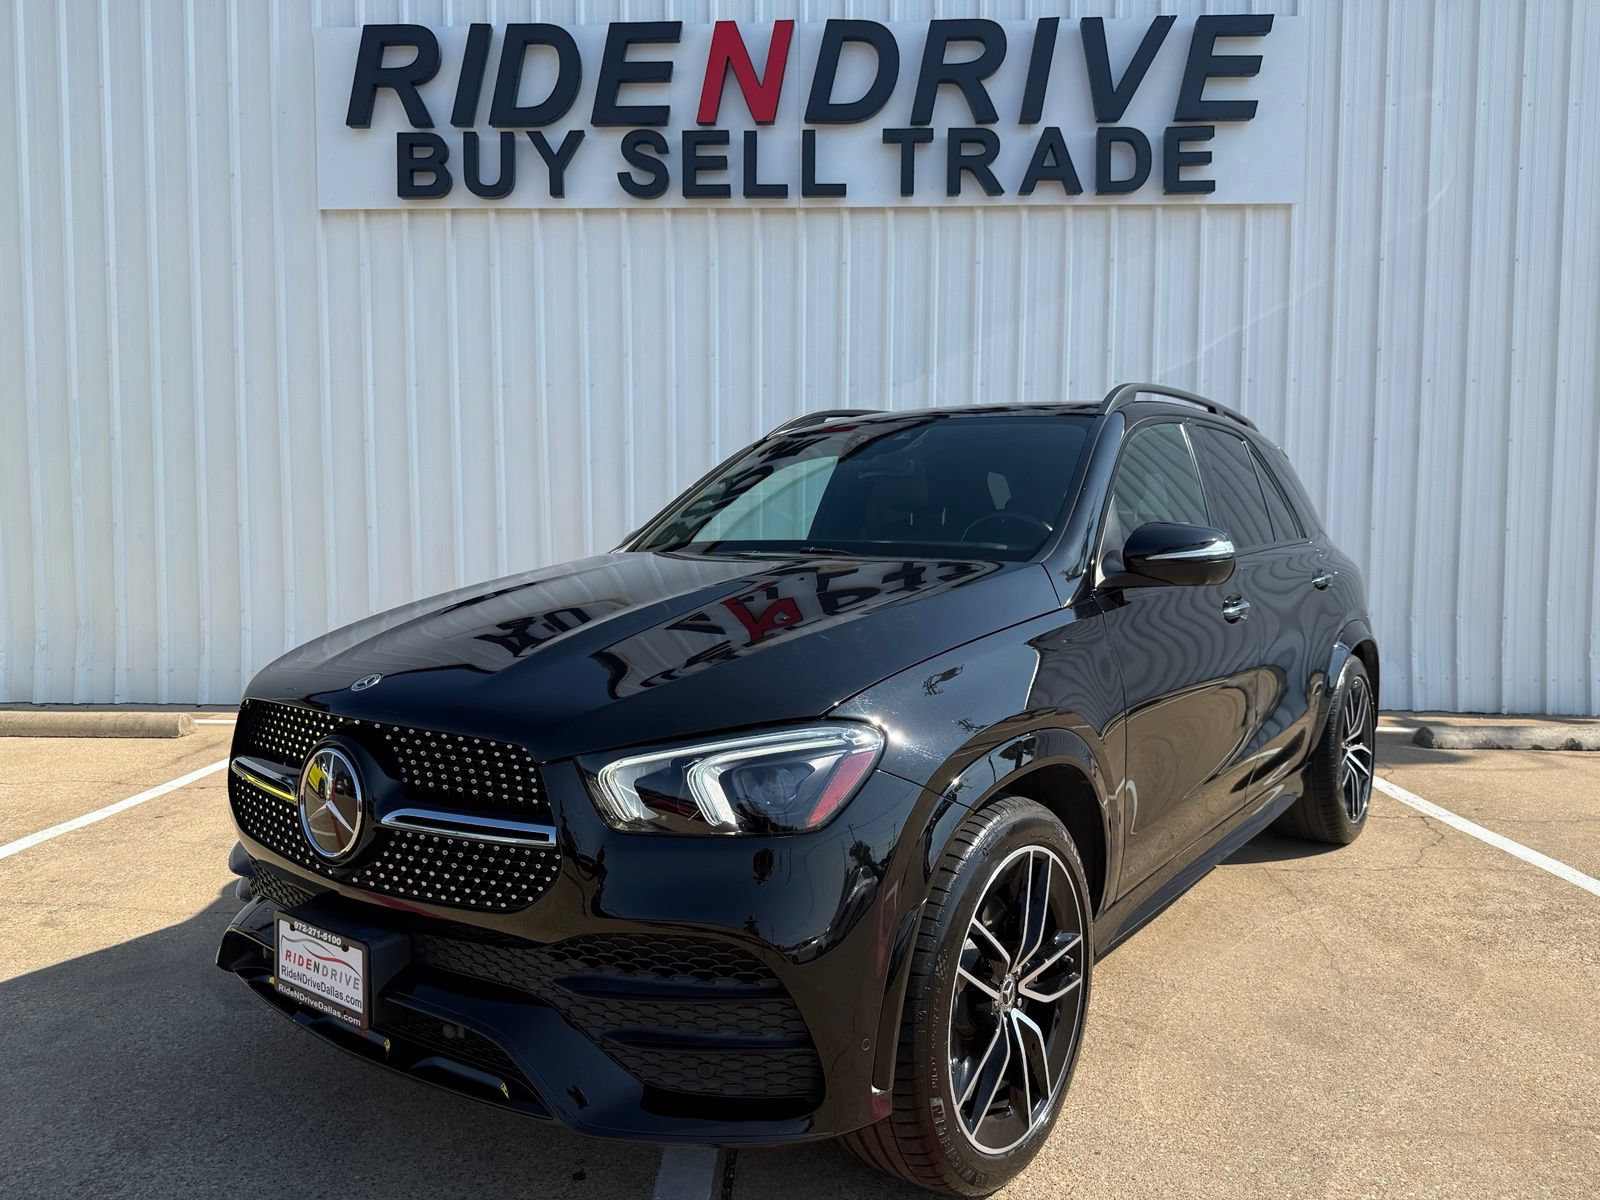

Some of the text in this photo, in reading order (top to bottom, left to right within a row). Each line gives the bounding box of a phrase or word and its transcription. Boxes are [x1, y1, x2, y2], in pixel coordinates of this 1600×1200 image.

[397, 125, 1216, 199] BUY SELL TRADE
[294, 921, 342, 946] 972-271-5100
[281, 965, 362, 1008] RideNDriveDallas.com
[285, 949, 361, 990] RIDENDRIVE
[278, 983, 361, 1026] RideNDriveDallas.com
